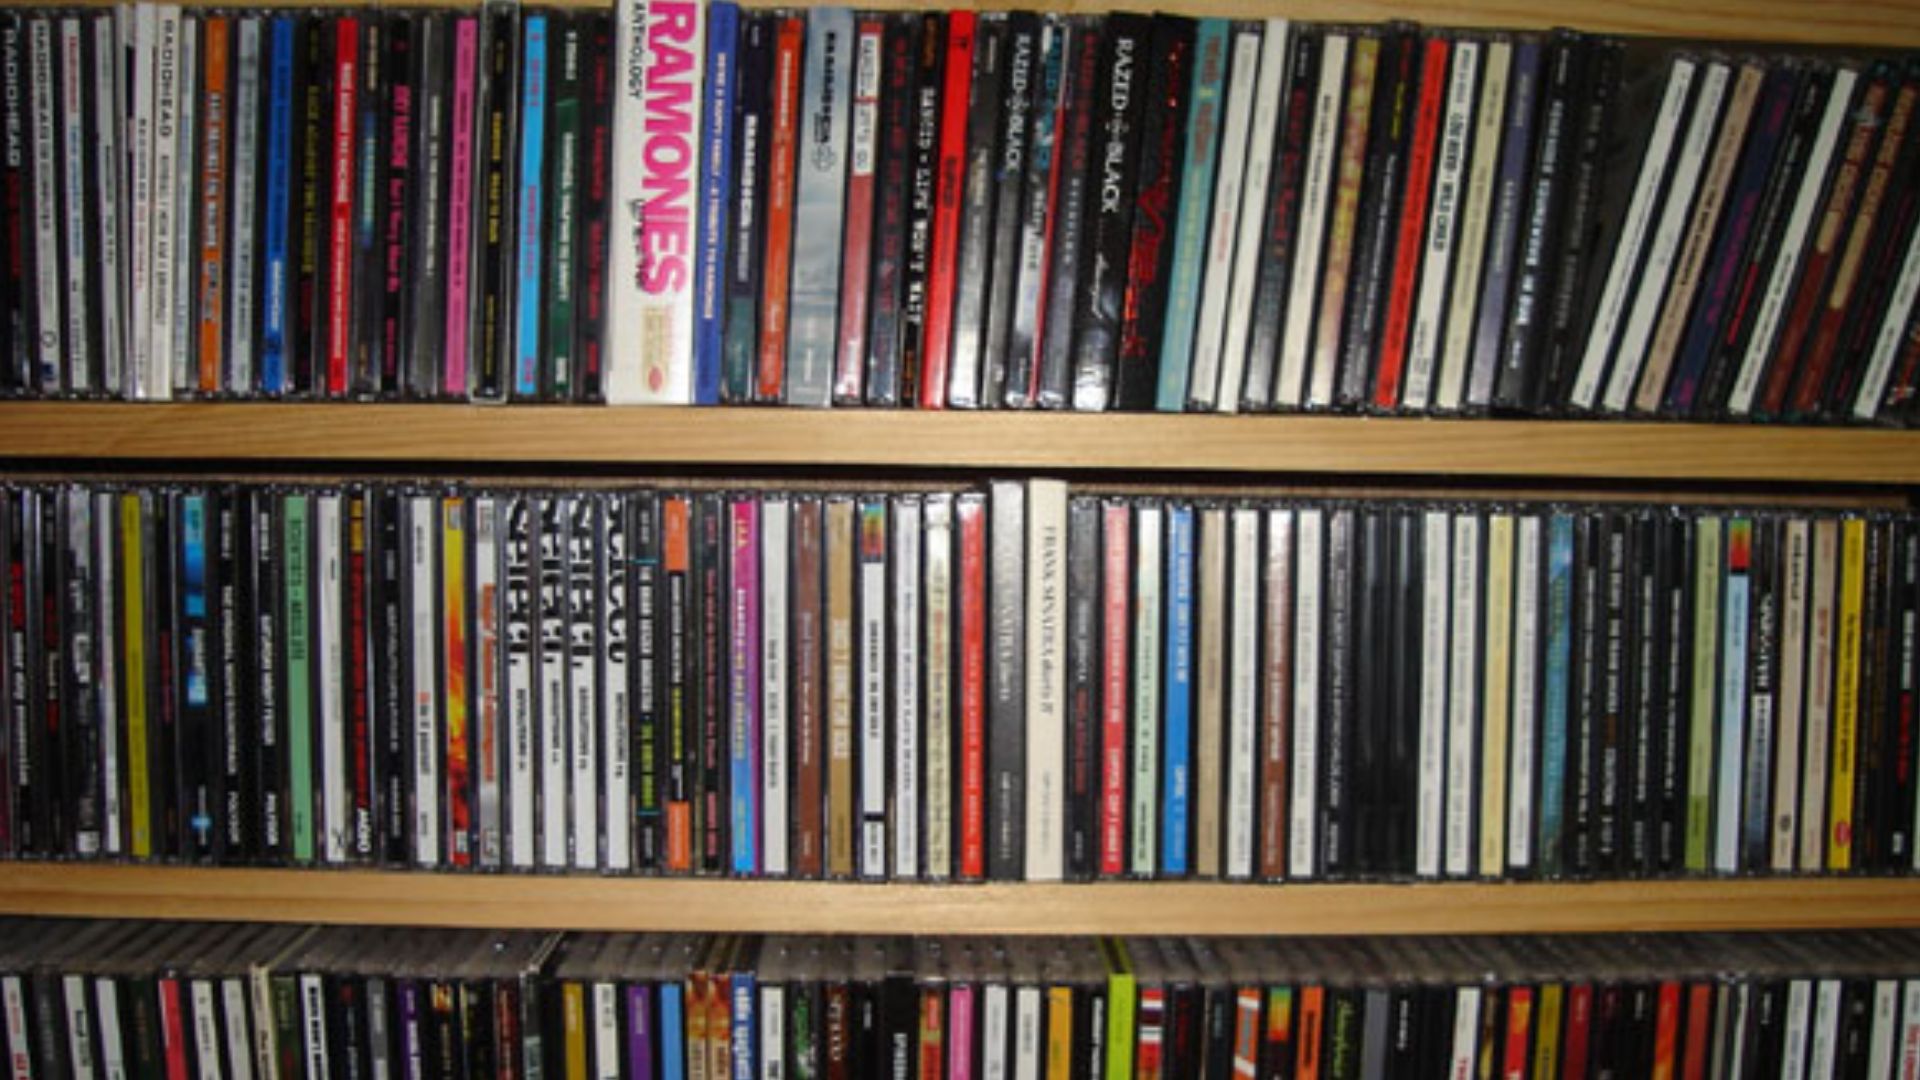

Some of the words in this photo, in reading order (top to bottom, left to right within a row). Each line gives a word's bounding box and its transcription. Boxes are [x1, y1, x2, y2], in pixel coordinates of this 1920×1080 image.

[160, 20, 173, 139] RADIOHEAD
[629, 2, 646, 99] ANTHOLOGY
[1013, 35, 1031, 90] RAZED
[1112, 39, 1134, 110] RAZED
[4, 31, 20, 167] RADIOHEAD
[918, 87, 936, 149] RANCID
[642, 0, 696, 295] RAMONES
[1005, 114, 1023, 172] BLACK
[915, 168, 929, 209] LIFE
[1102, 141, 1124, 214] BLACK
[911, 220, 927, 271] WON'T
[907, 283, 923, 324] WAIT
[1043, 526, 1057, 582] FRANK
[1040, 584, 1057, 658] SINATRA
